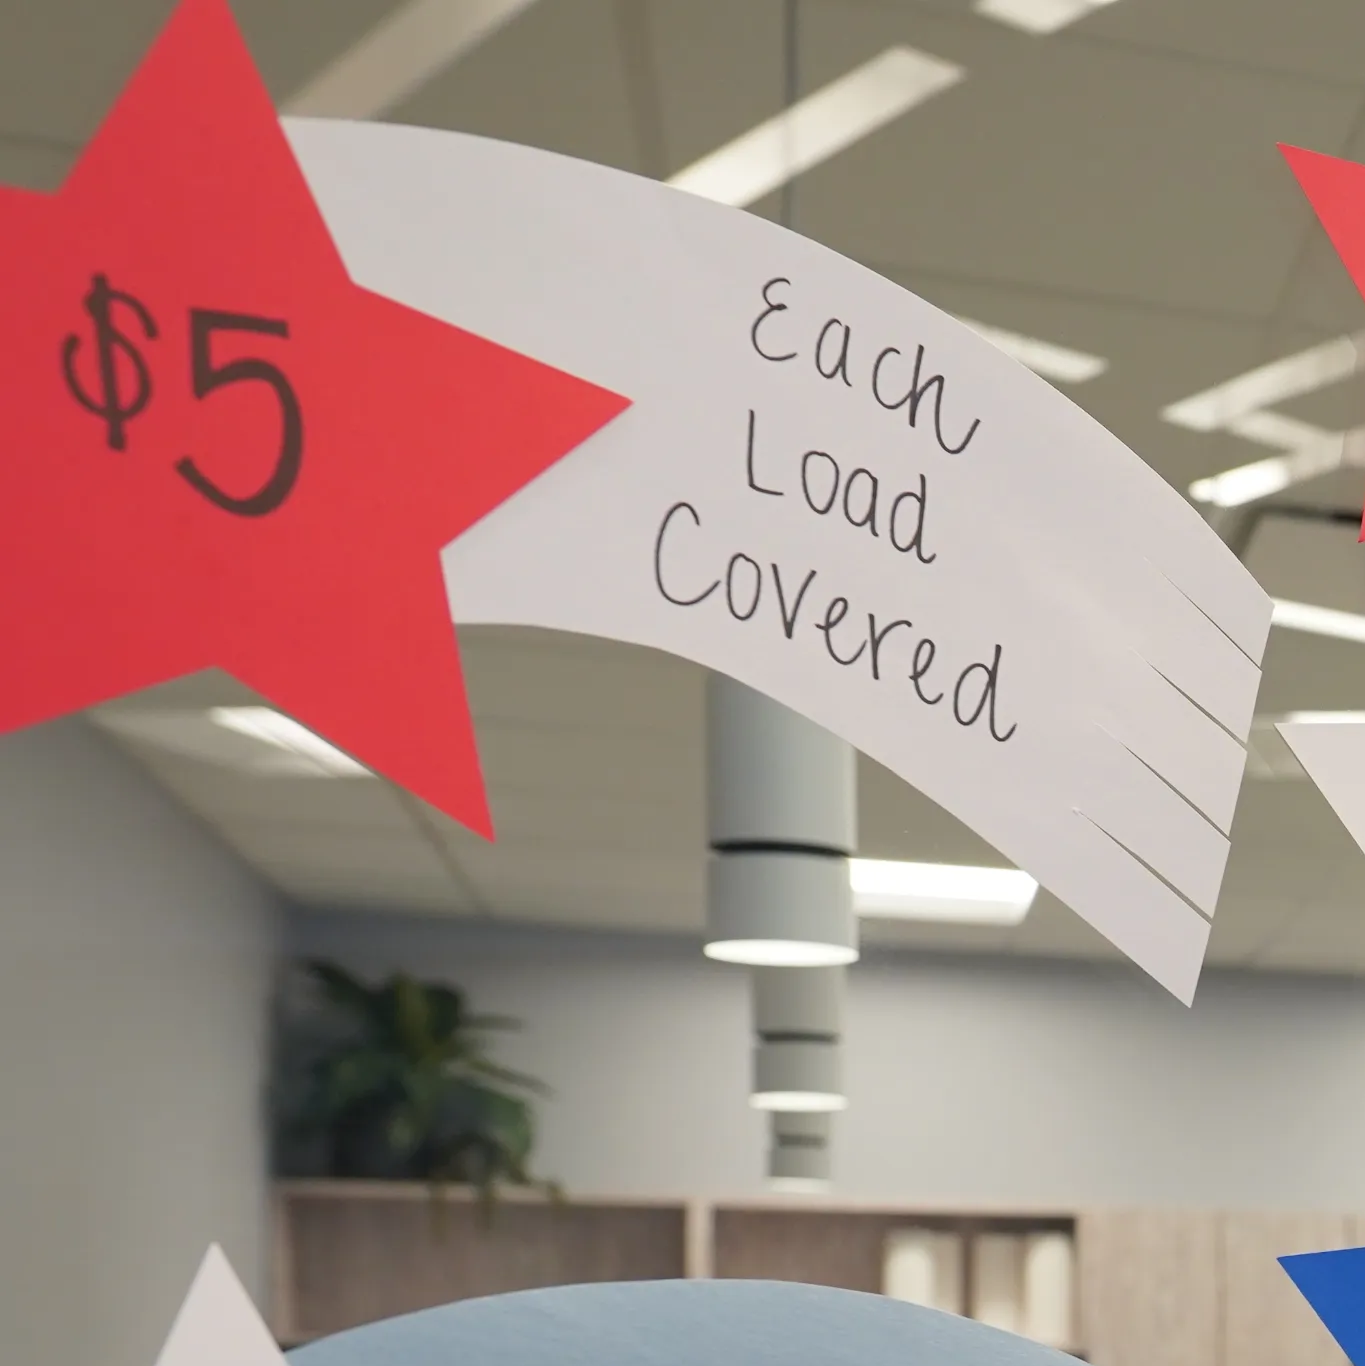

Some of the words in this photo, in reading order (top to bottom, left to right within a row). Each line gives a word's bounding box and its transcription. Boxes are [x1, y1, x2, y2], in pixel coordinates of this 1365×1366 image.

[60, 273, 304, 519] $5
[750, 276, 982, 456] Each
[746, 408, 938, 565] Load
[653, 500, 1018, 744] Covered
